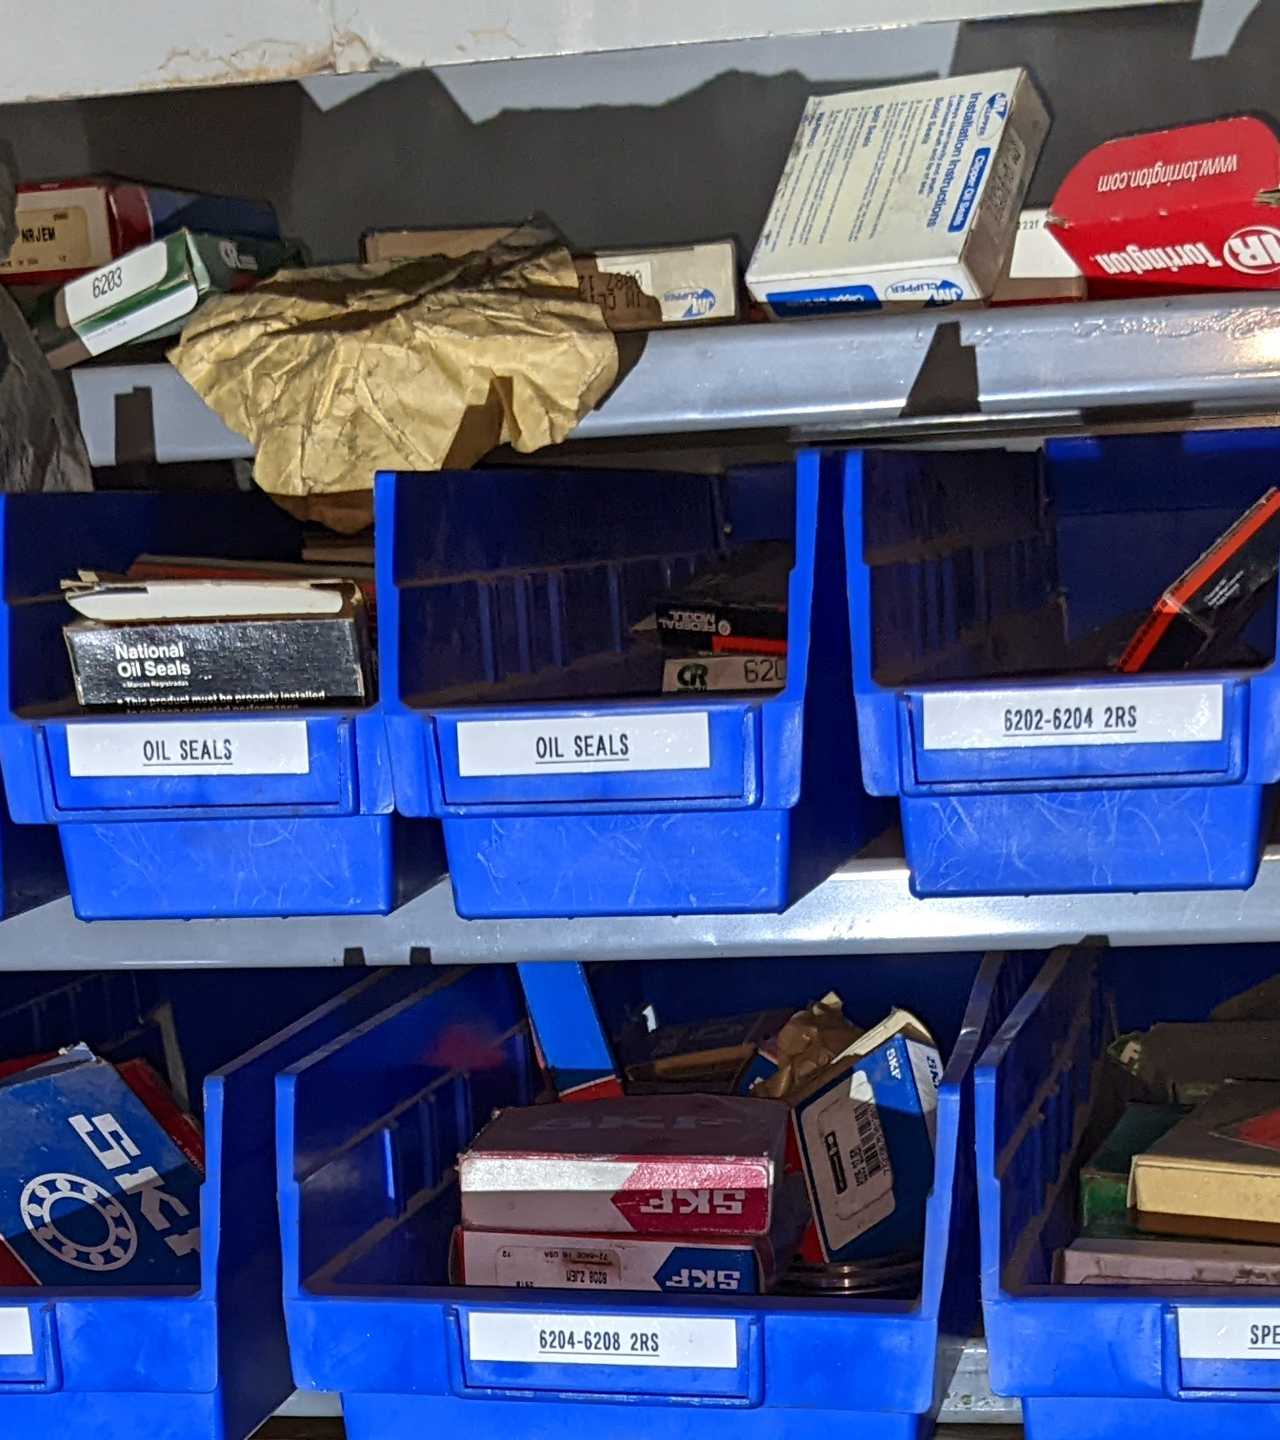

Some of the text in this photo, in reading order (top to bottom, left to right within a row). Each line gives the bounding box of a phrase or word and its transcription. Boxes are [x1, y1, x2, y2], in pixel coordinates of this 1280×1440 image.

[925, 90, 982, 230] Installation Instructions
[1097, 153, 1239, 192] www.torrington.com
[22, 227, 56, 244] NRJEM
[1097, 241, 1224, 275] Torrington
[92, 267, 123, 298] 6203
[115, 641, 185, 660] National
[118, 660, 191, 678] Oil Seals
[191, 694, 217, 703] must
[235, 691, 279, 703] properly
[280, 690, 326, 700] installed
[1004, 705, 1138, 732] 6202-6204 2RS
[144, 739, 233, 762] OIL SEALS
[536, 734, 629, 759] OIL SEALS
[886, 1048, 902, 1080] SKF
[640, 1189, 746, 1215] SKF
[666, 1269, 740, 1290] SKF
[539, 1329, 660, 1352] 6204-6208 2RS
